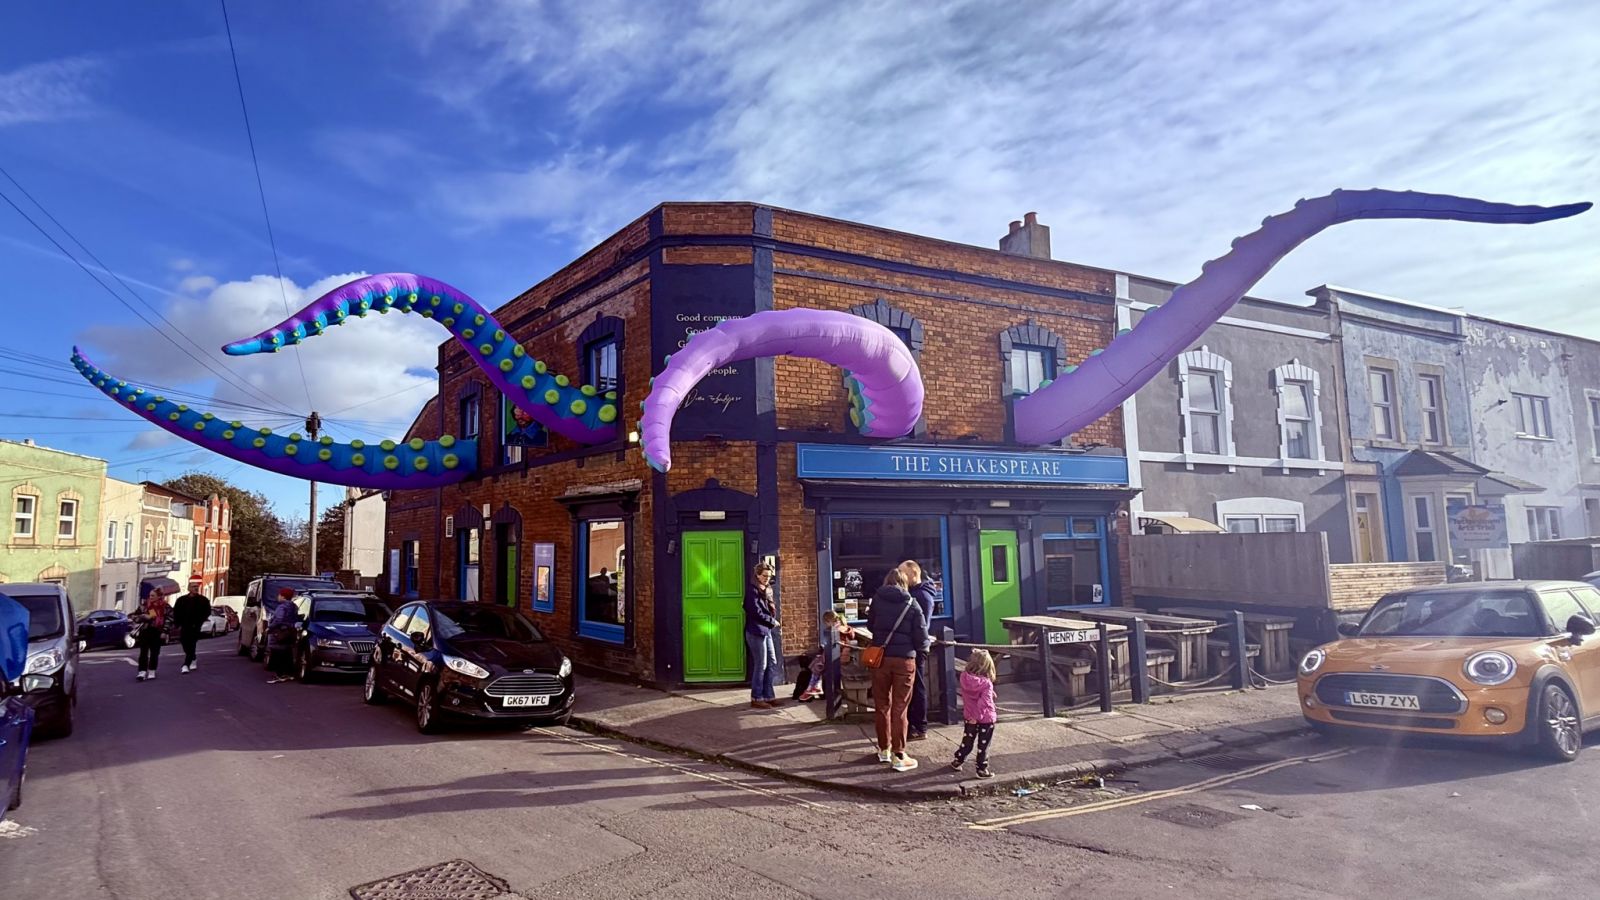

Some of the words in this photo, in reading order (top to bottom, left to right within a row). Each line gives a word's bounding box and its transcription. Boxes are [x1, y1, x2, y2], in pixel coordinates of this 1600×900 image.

[676, 313, 701, 322] Good
[891, 455, 931, 472] THE
[938, 457, 1062, 476] SHAKESPEARE
[1049, 631, 1075, 643] HENRY
[1077, 630, 1088, 641] ST
[507, 696, 529, 705] GK67
[531, 695, 547, 705] VFC
[1352, 693, 1385, 706] LG67
[1389, 695, 1418, 708] ZYX
